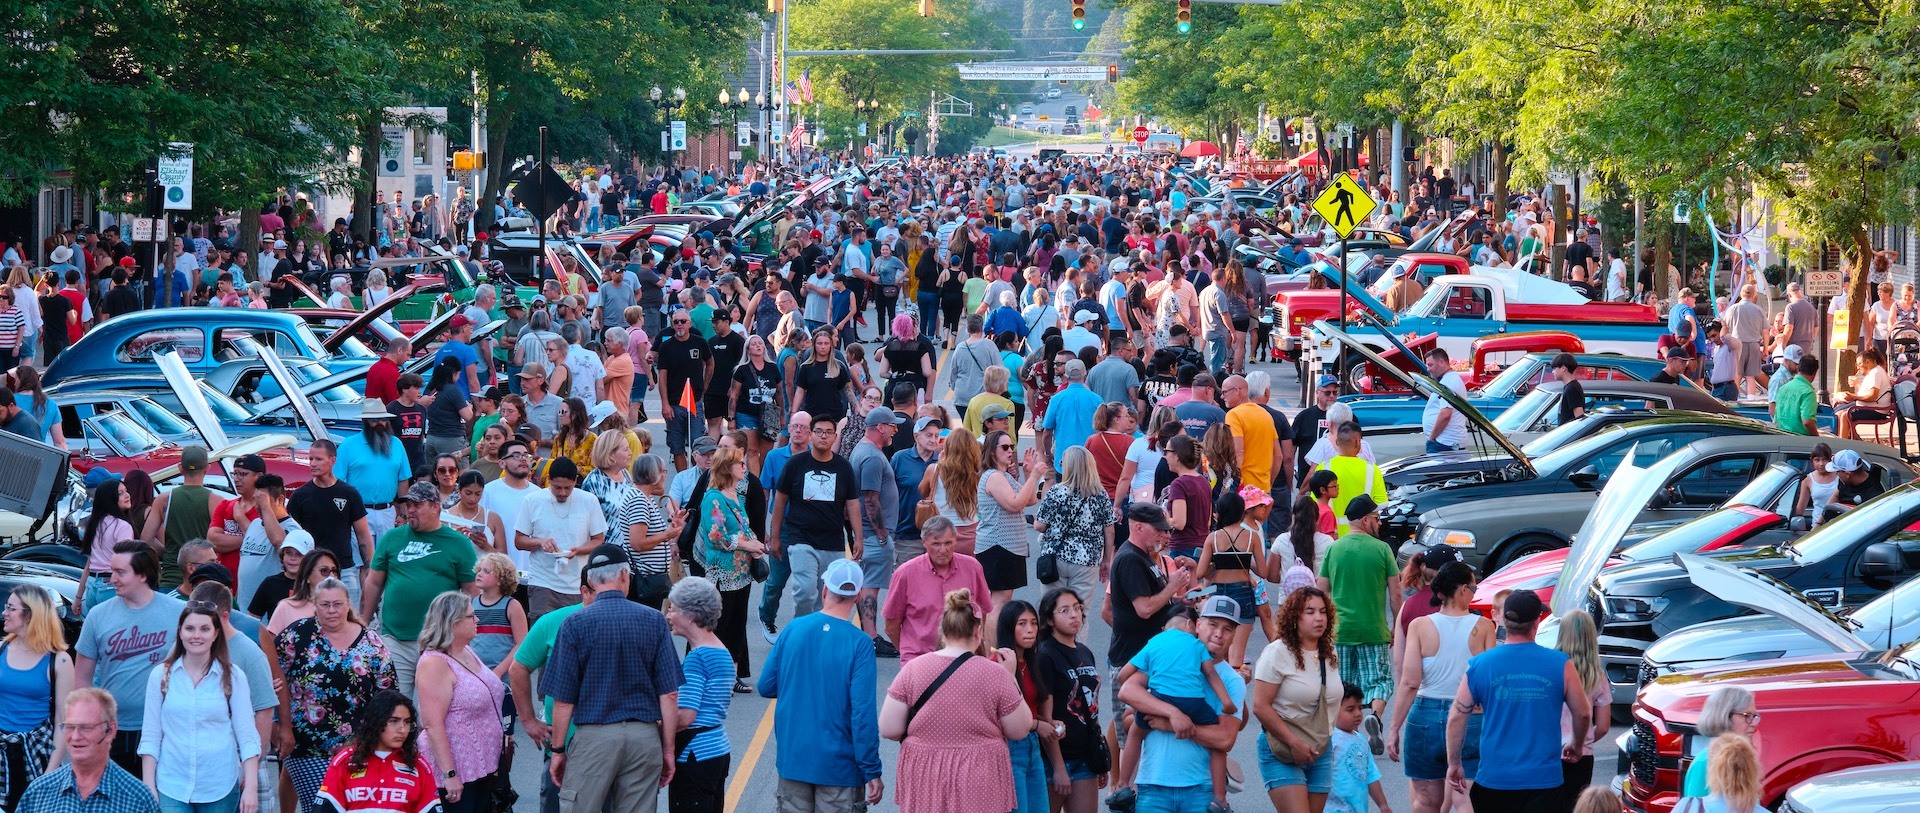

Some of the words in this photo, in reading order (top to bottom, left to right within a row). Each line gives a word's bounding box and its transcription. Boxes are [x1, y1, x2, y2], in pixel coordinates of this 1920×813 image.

[160, 173, 186, 182] County
[404, 541, 433, 554] NIKE
[105, 626, 167, 656] Indiana
[1507, 672, 1553, 686] Anniversary
[345, 787, 408, 803] NEXTEL
